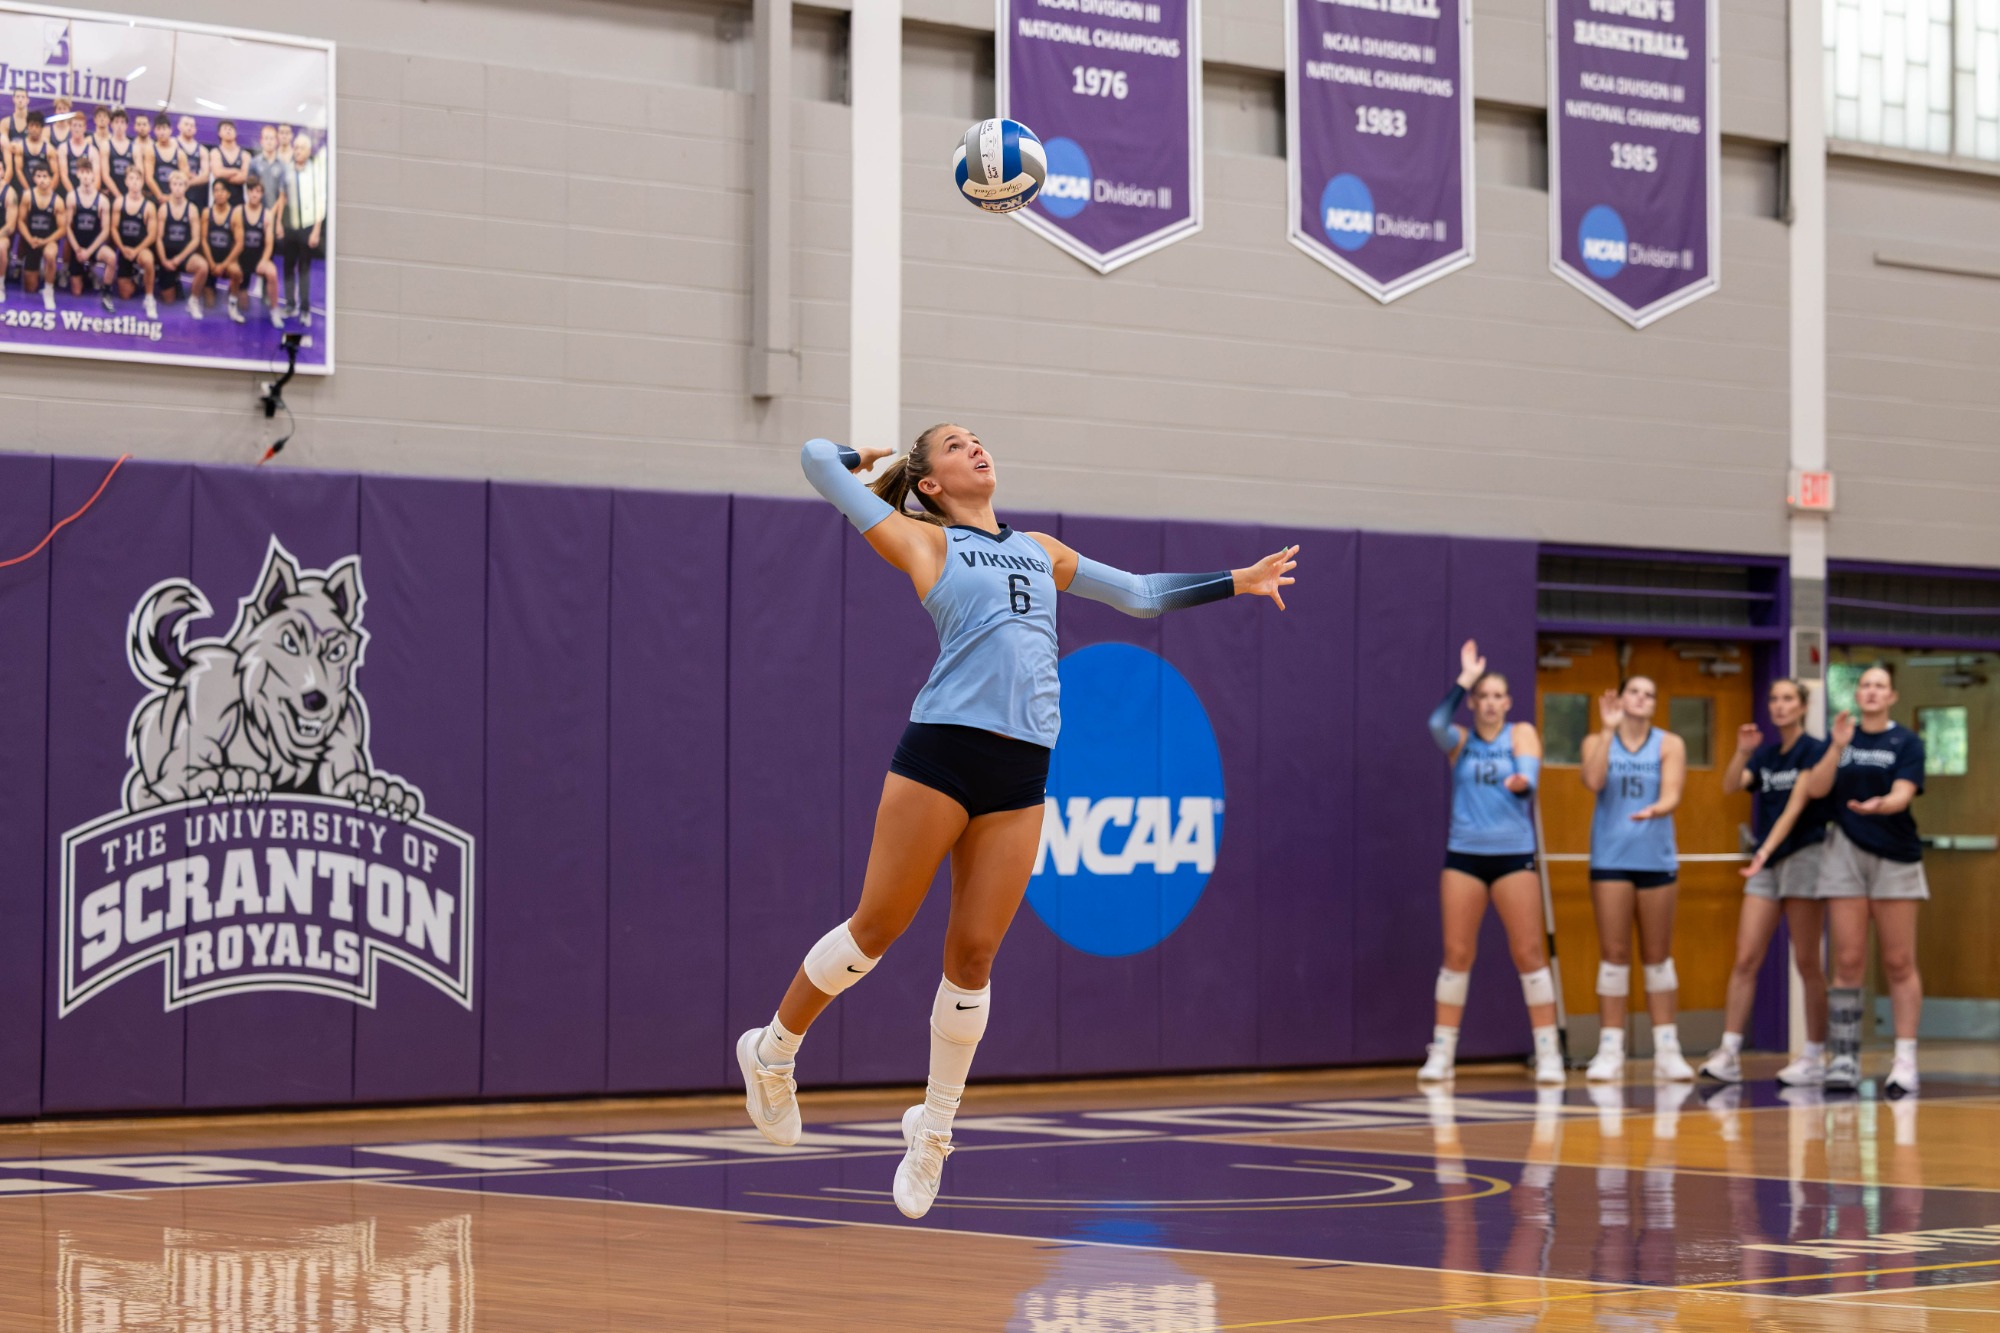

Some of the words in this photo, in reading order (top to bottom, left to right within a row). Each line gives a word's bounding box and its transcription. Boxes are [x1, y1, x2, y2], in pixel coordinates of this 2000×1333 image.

[1080, 0, 1144, 21] DIVISION
[1145, 4, 1161, 23] III
[1018, 17, 1091, 46] NATIONAL
[1092, 28, 1181, 58] CHAMPIONS
[1323, 31, 1361, 54] NCAA
[1361, 36, 1422, 63] DIVISION
[1574, 19, 1689, 60] BASKETBALL
[1072, 65, 1129, 100] 1976
[1306, 60, 1373, 87] NATIONAL
[1373, 69, 1454, 98] CHAMPIONS
[1580, 71, 1615, 94] NCAA
[1616, 77, 1670, 101] DIVISION
[1355, 105, 1408, 138] 1983
[1565, 98, 1626, 125] NATIONAL
[1626, 108, 1702, 135] CHAMPIONS
[1610, 141, 1659, 173] 1985
[980, 194, 1023, 211] NCAA
[1039, 174, 1091, 201] NCAA
[1093, 179, 1157, 208] Division
[1157, 187, 1172, 210] III
[1326, 207, 1374, 234] NCAA
[1375, 212, 1433, 240] Division
[1583, 238, 1627, 263] NCAA
[1628, 242, 1681, 269] Division
[60, 310, 163, 341] Wrestling
[958, 550, 1053, 578] VIKINGS
[1008, 573, 1032, 615] 6
[1474, 762, 1498, 786] 12
[1619, 776, 1644, 799] 15
[101, 822, 167, 874] THE
[184, 808, 388, 854] UNIVERSITY
[402, 832, 440, 875] OF
[1031, 796, 1216, 875] NCAA
[81, 846, 456, 972] SCRANTON
[183, 921, 361, 980] ROYALS
[0, 1097, 1638, 1193] RANTON
